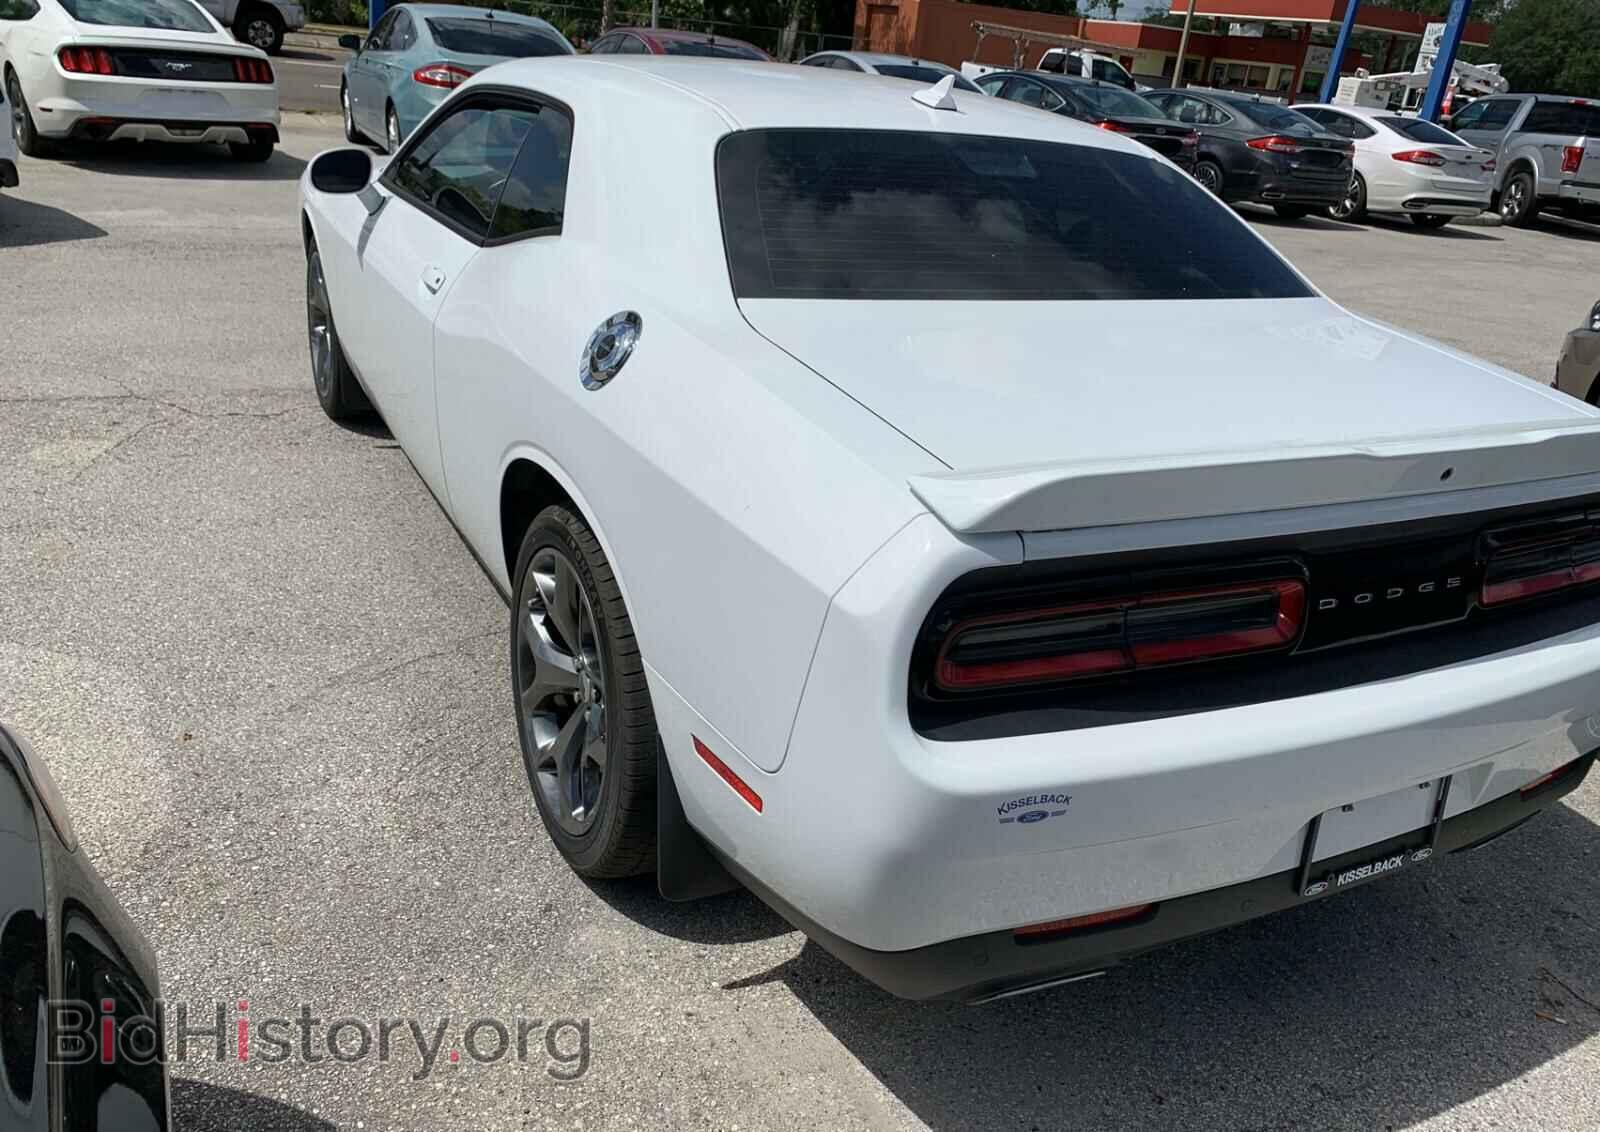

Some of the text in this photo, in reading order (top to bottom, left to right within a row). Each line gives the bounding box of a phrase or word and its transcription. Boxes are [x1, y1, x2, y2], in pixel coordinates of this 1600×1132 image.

[1319, 577, 1462, 609] DODGE
[997, 794, 1072, 815] KISSELBACK
[1337, 855, 1405, 886] KISSELBACK
